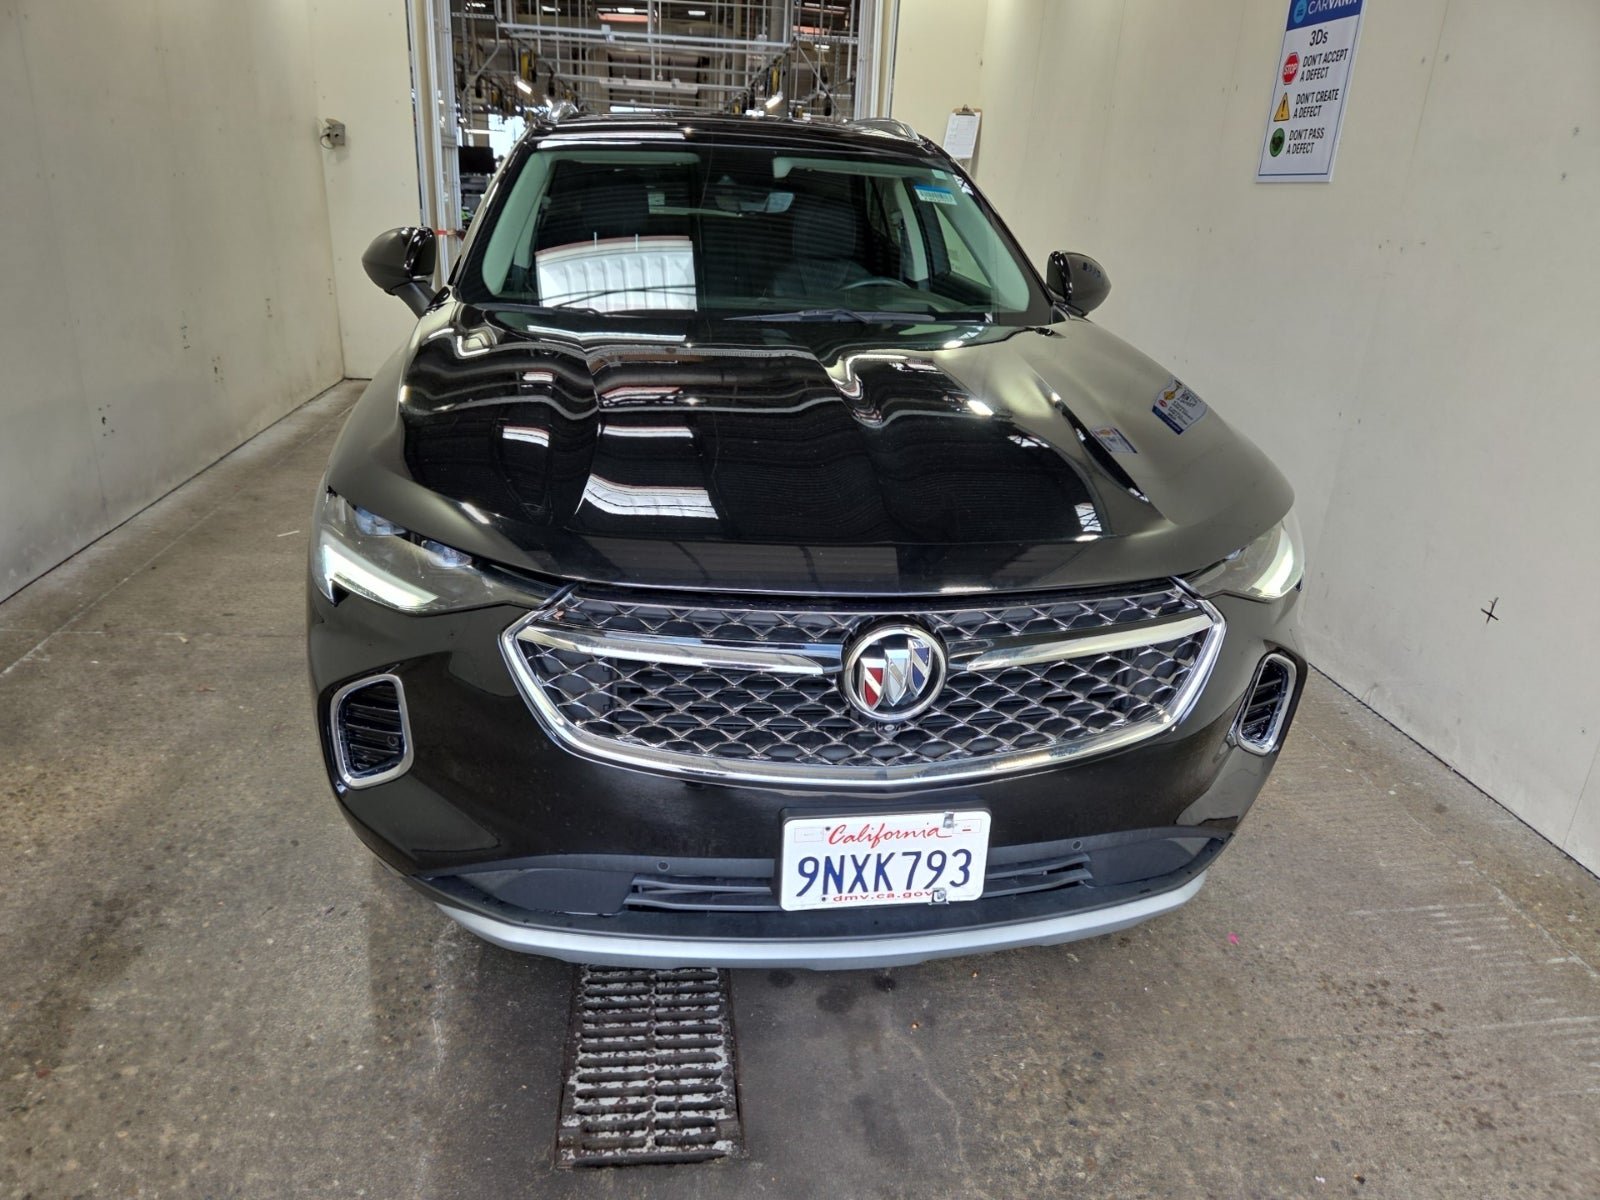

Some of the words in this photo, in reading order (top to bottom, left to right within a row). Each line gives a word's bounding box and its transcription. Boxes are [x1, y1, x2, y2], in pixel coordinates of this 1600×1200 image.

[1309, 29, 1329, 46] 3Ds
[1303, 53, 1323, 67] DON'T
[1322, 48, 1348, 64] ACCEPT
[1300, 70, 1305, 82] A
[1305, 66, 1329, 81] DEFECT
[1296, 91, 1316, 105] DON'T
[1315, 88, 1340, 103] CREATE
[1293, 107, 1298, 119] A
[1299, 105, 1322, 118] DEFECT
[1289, 129, 1309, 141] DON'T
[1308, 127, 1325, 140] PASS
[1286, 143, 1291, 154] A
[1291, 142, 1315, 155] DEFECT
[829, 823, 953, 849] California
[796, 848, 972, 898] 9NXK793
[833, 889, 934, 902] dmv.ca.gov
